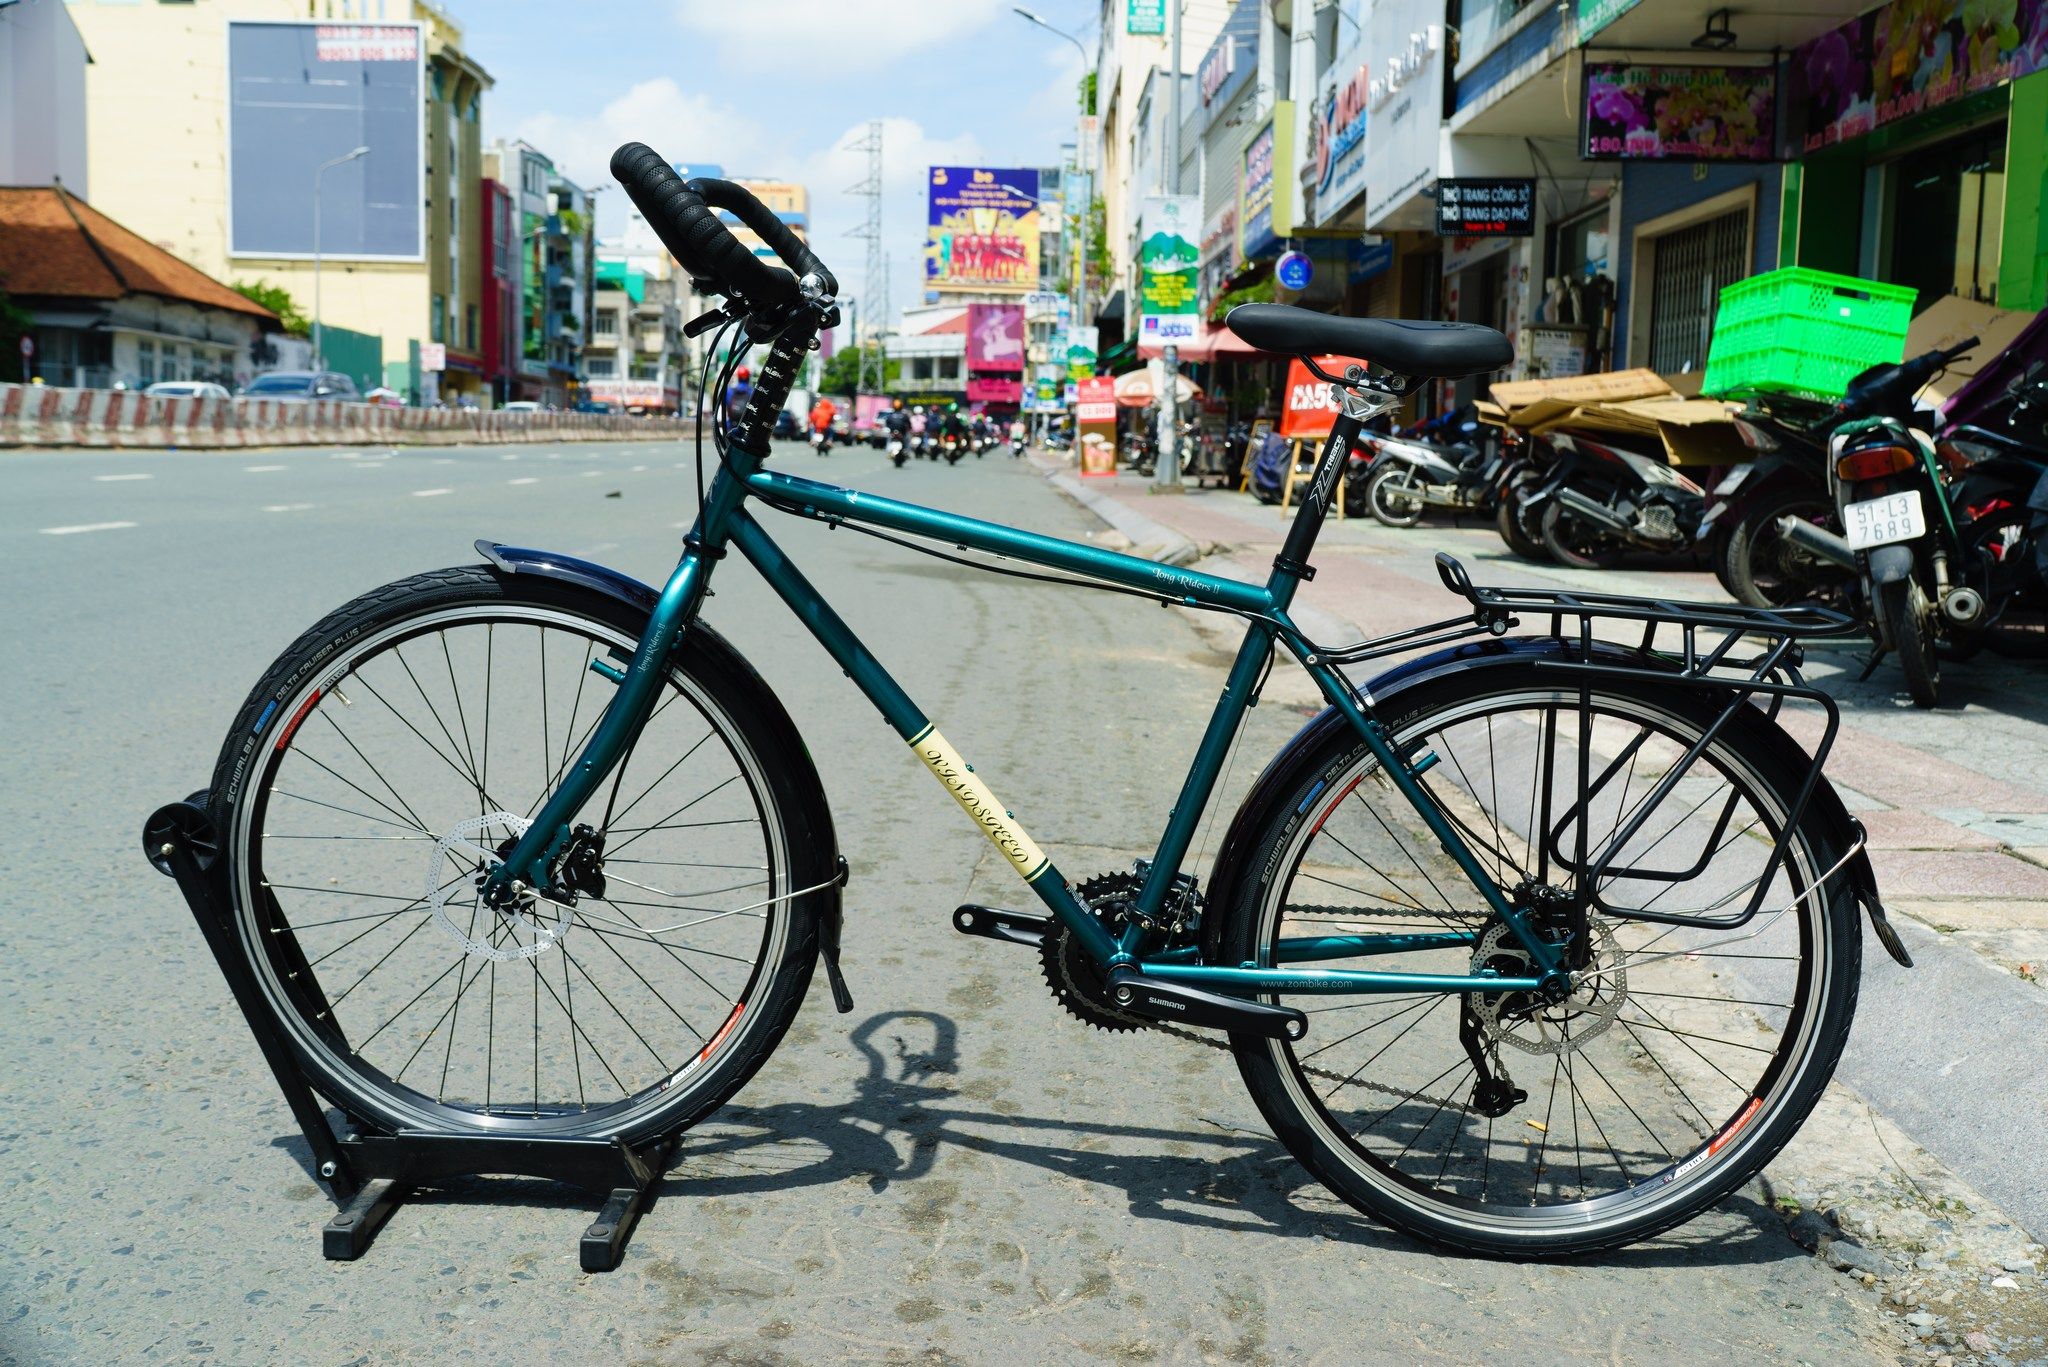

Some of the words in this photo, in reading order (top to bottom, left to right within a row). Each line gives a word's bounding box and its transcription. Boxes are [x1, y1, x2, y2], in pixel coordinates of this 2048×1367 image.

[1463, 207, 1490, 221] TRANG
[1860, 518, 1912, 541] 7689
[1177, 575, 1211, 590] Riders
[227, 735, 255, 804] SCHWALBE
[276, 673, 300, 701] DELTA
[299, 644, 334, 676] CRUISER
[334, 627, 359, 647] PLUS
[1392, 709, 1418, 728] PLUS
[1261, 815, 1297, 885] SCHWALBE
[1325, 754, 1352, 780] DELTA
[1260, 979, 1353, 988] www.zombike.com
[1148, 996, 1185, 1010] SHIMANO
